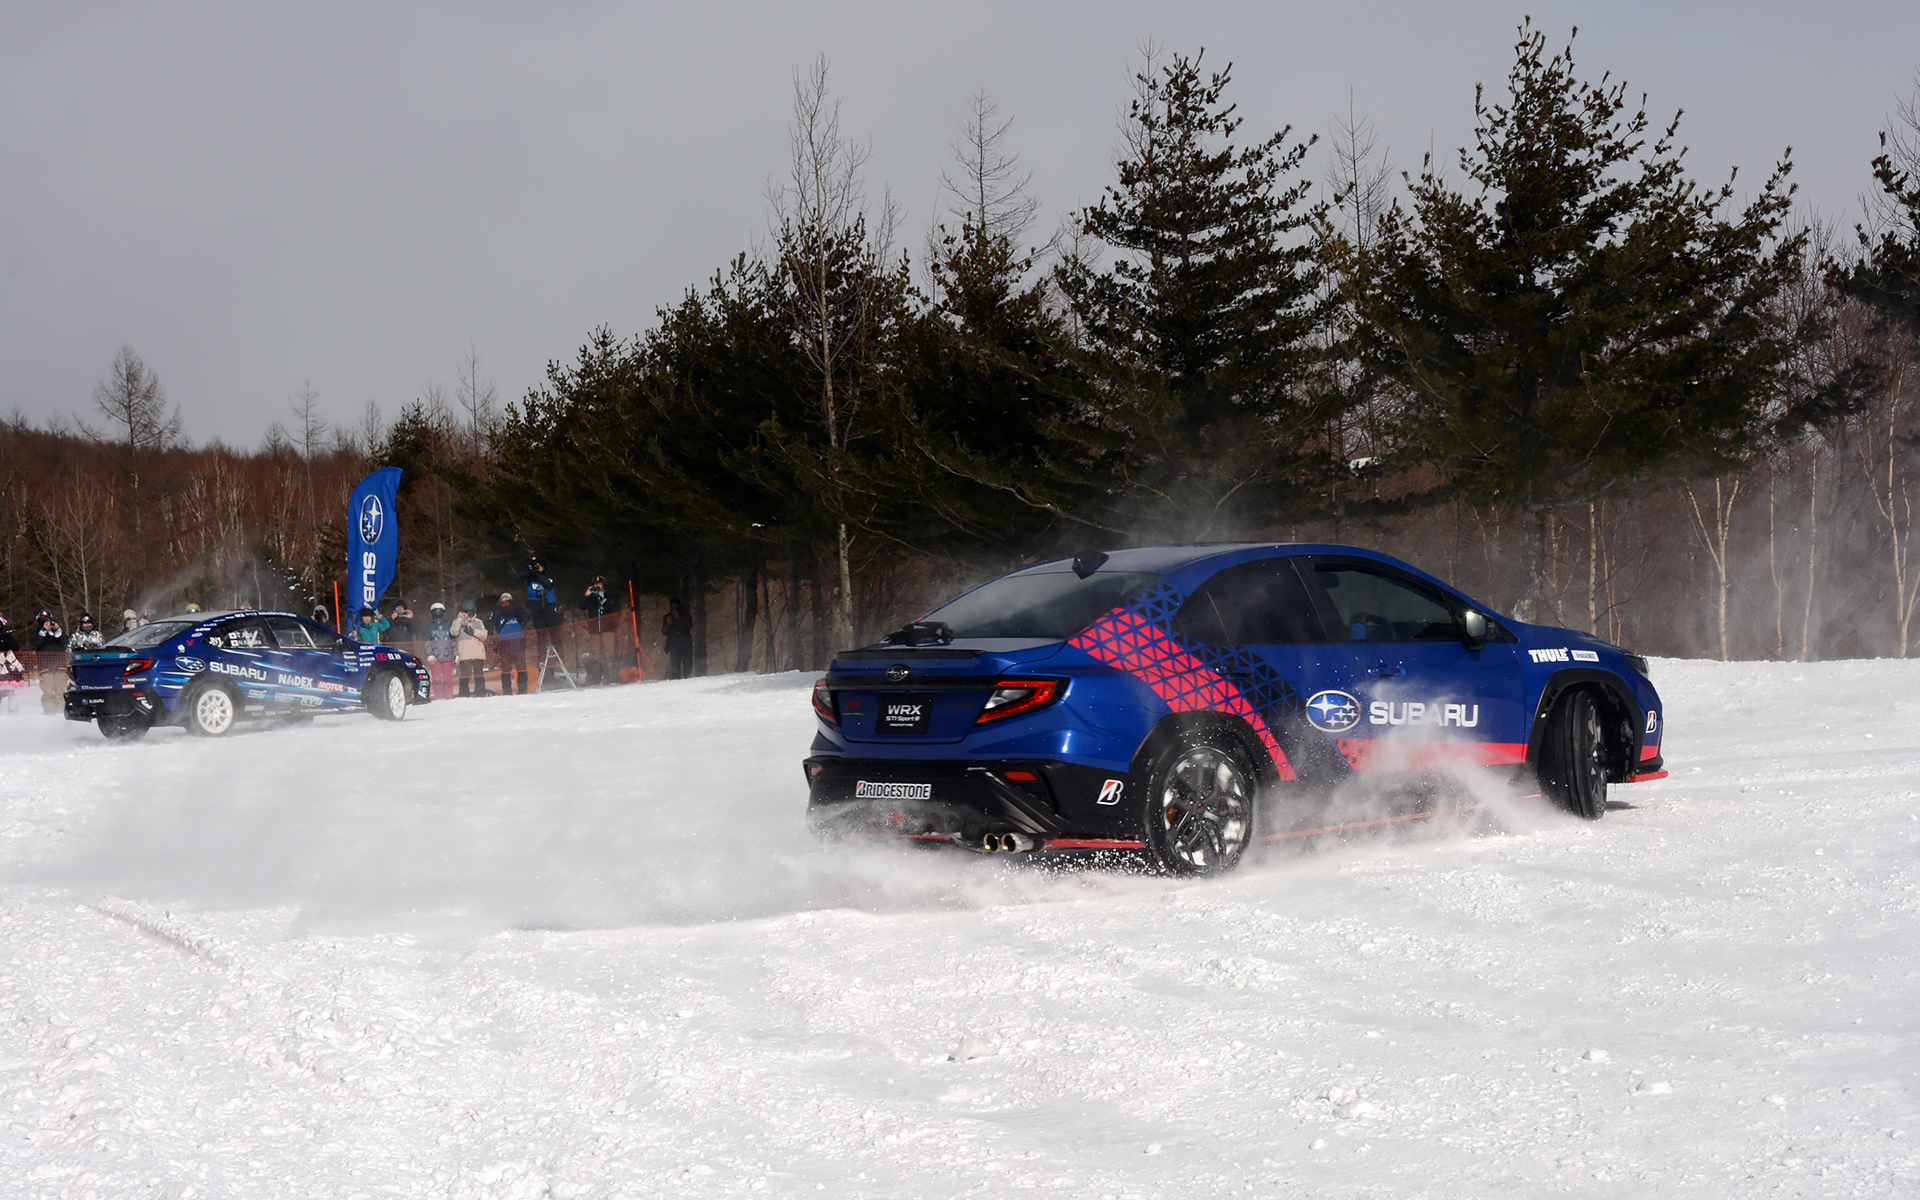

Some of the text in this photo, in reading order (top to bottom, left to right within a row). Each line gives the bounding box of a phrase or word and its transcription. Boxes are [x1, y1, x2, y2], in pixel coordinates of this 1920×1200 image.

[1528, 648, 1569, 663] THULE
[210, 661, 267, 681] SUBARU
[278, 673, 313, 688] NADEX
[317, 681, 344, 692] MOTUL
[888, 704, 922, 715] WRX
[1369, 701, 1479, 728] SUBARU
[857, 781, 931, 799] BRIDGESTONE
